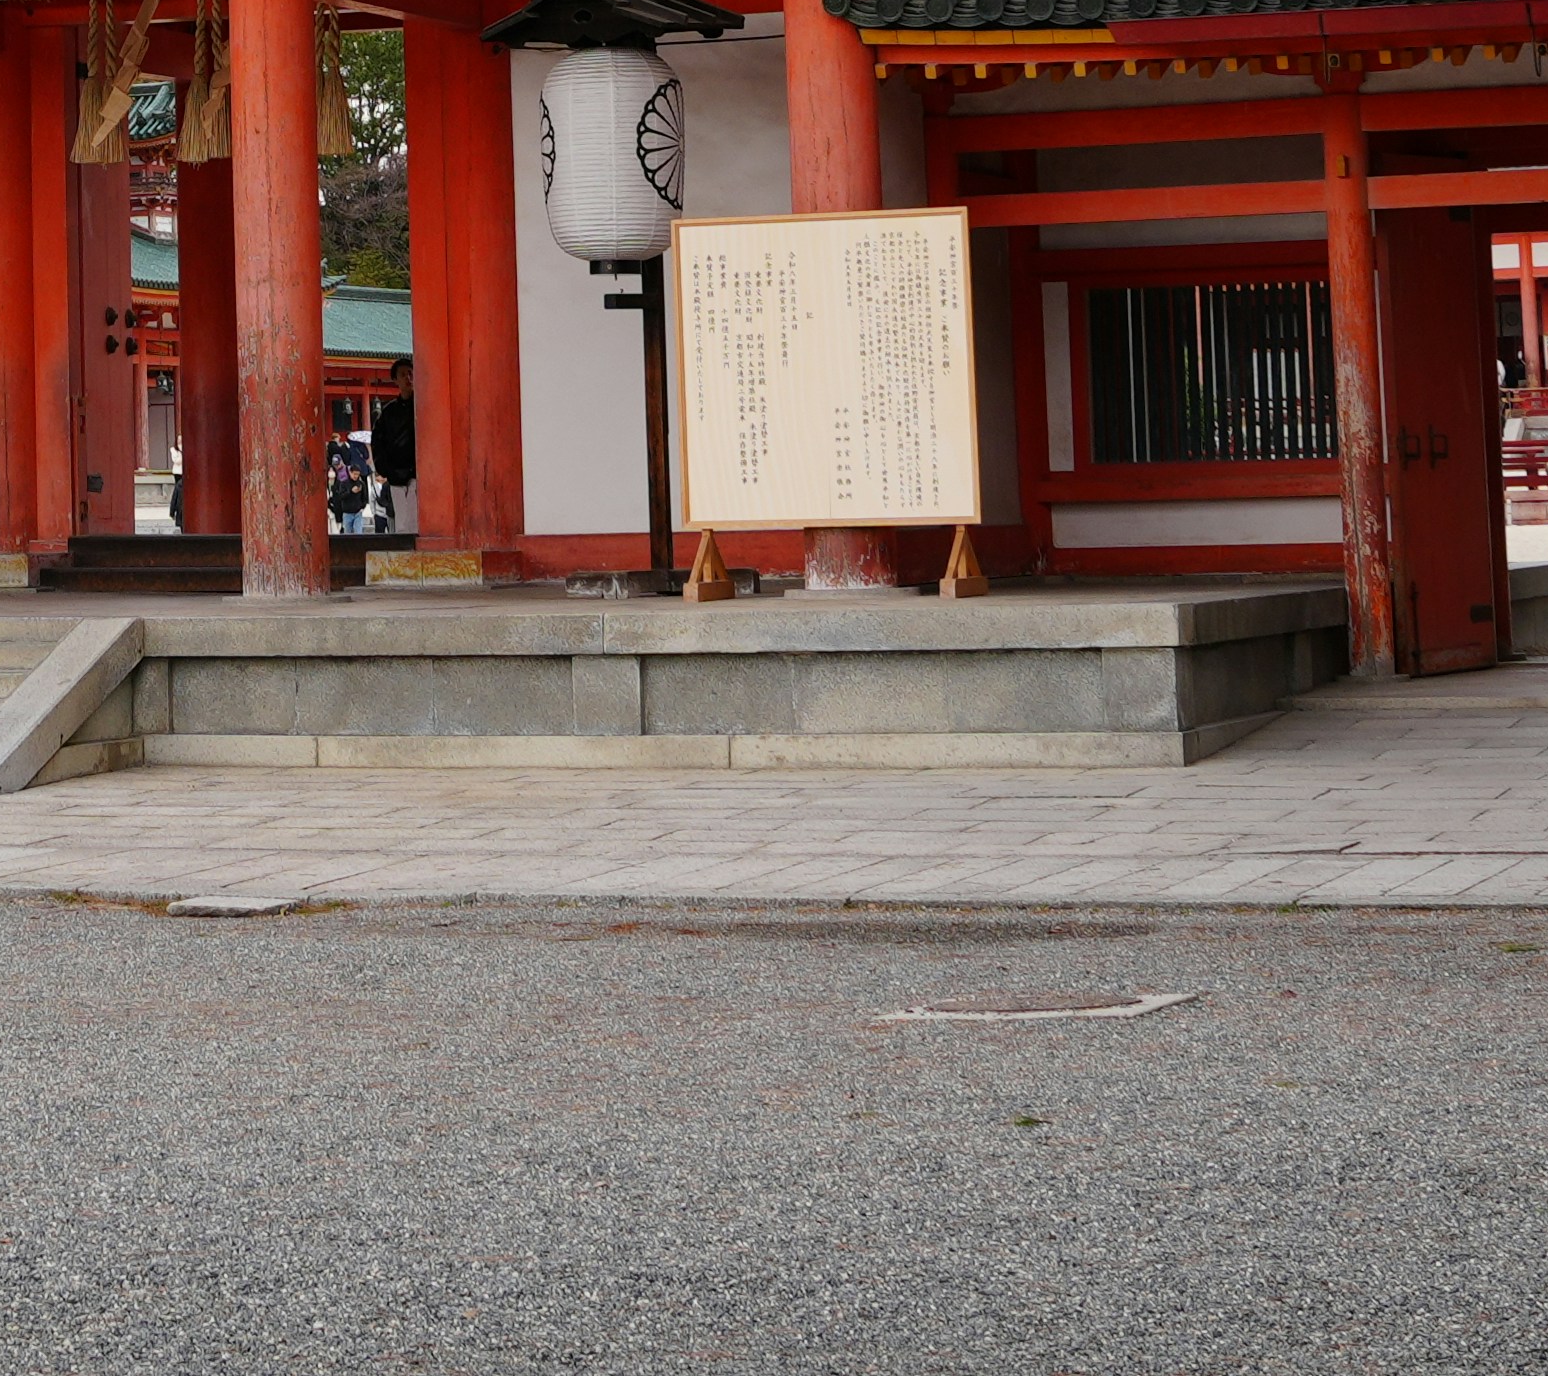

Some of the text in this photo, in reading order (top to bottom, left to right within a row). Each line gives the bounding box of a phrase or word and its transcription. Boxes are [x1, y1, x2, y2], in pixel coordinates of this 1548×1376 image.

[734, 271, 742, 315] 重要文化財
[755, 271, 763, 314] 重要文化財
[789, 251, 797, 330] 令和八年三月十五日
[949, 235, 958, 309] 平安神宮百三十年祭
[806, 311, 814, 320] 記
[938, 268, 951, 376] 記念事業 ご奉賛のお願い
[843, 407, 852, 499] 平安神宮社務所
